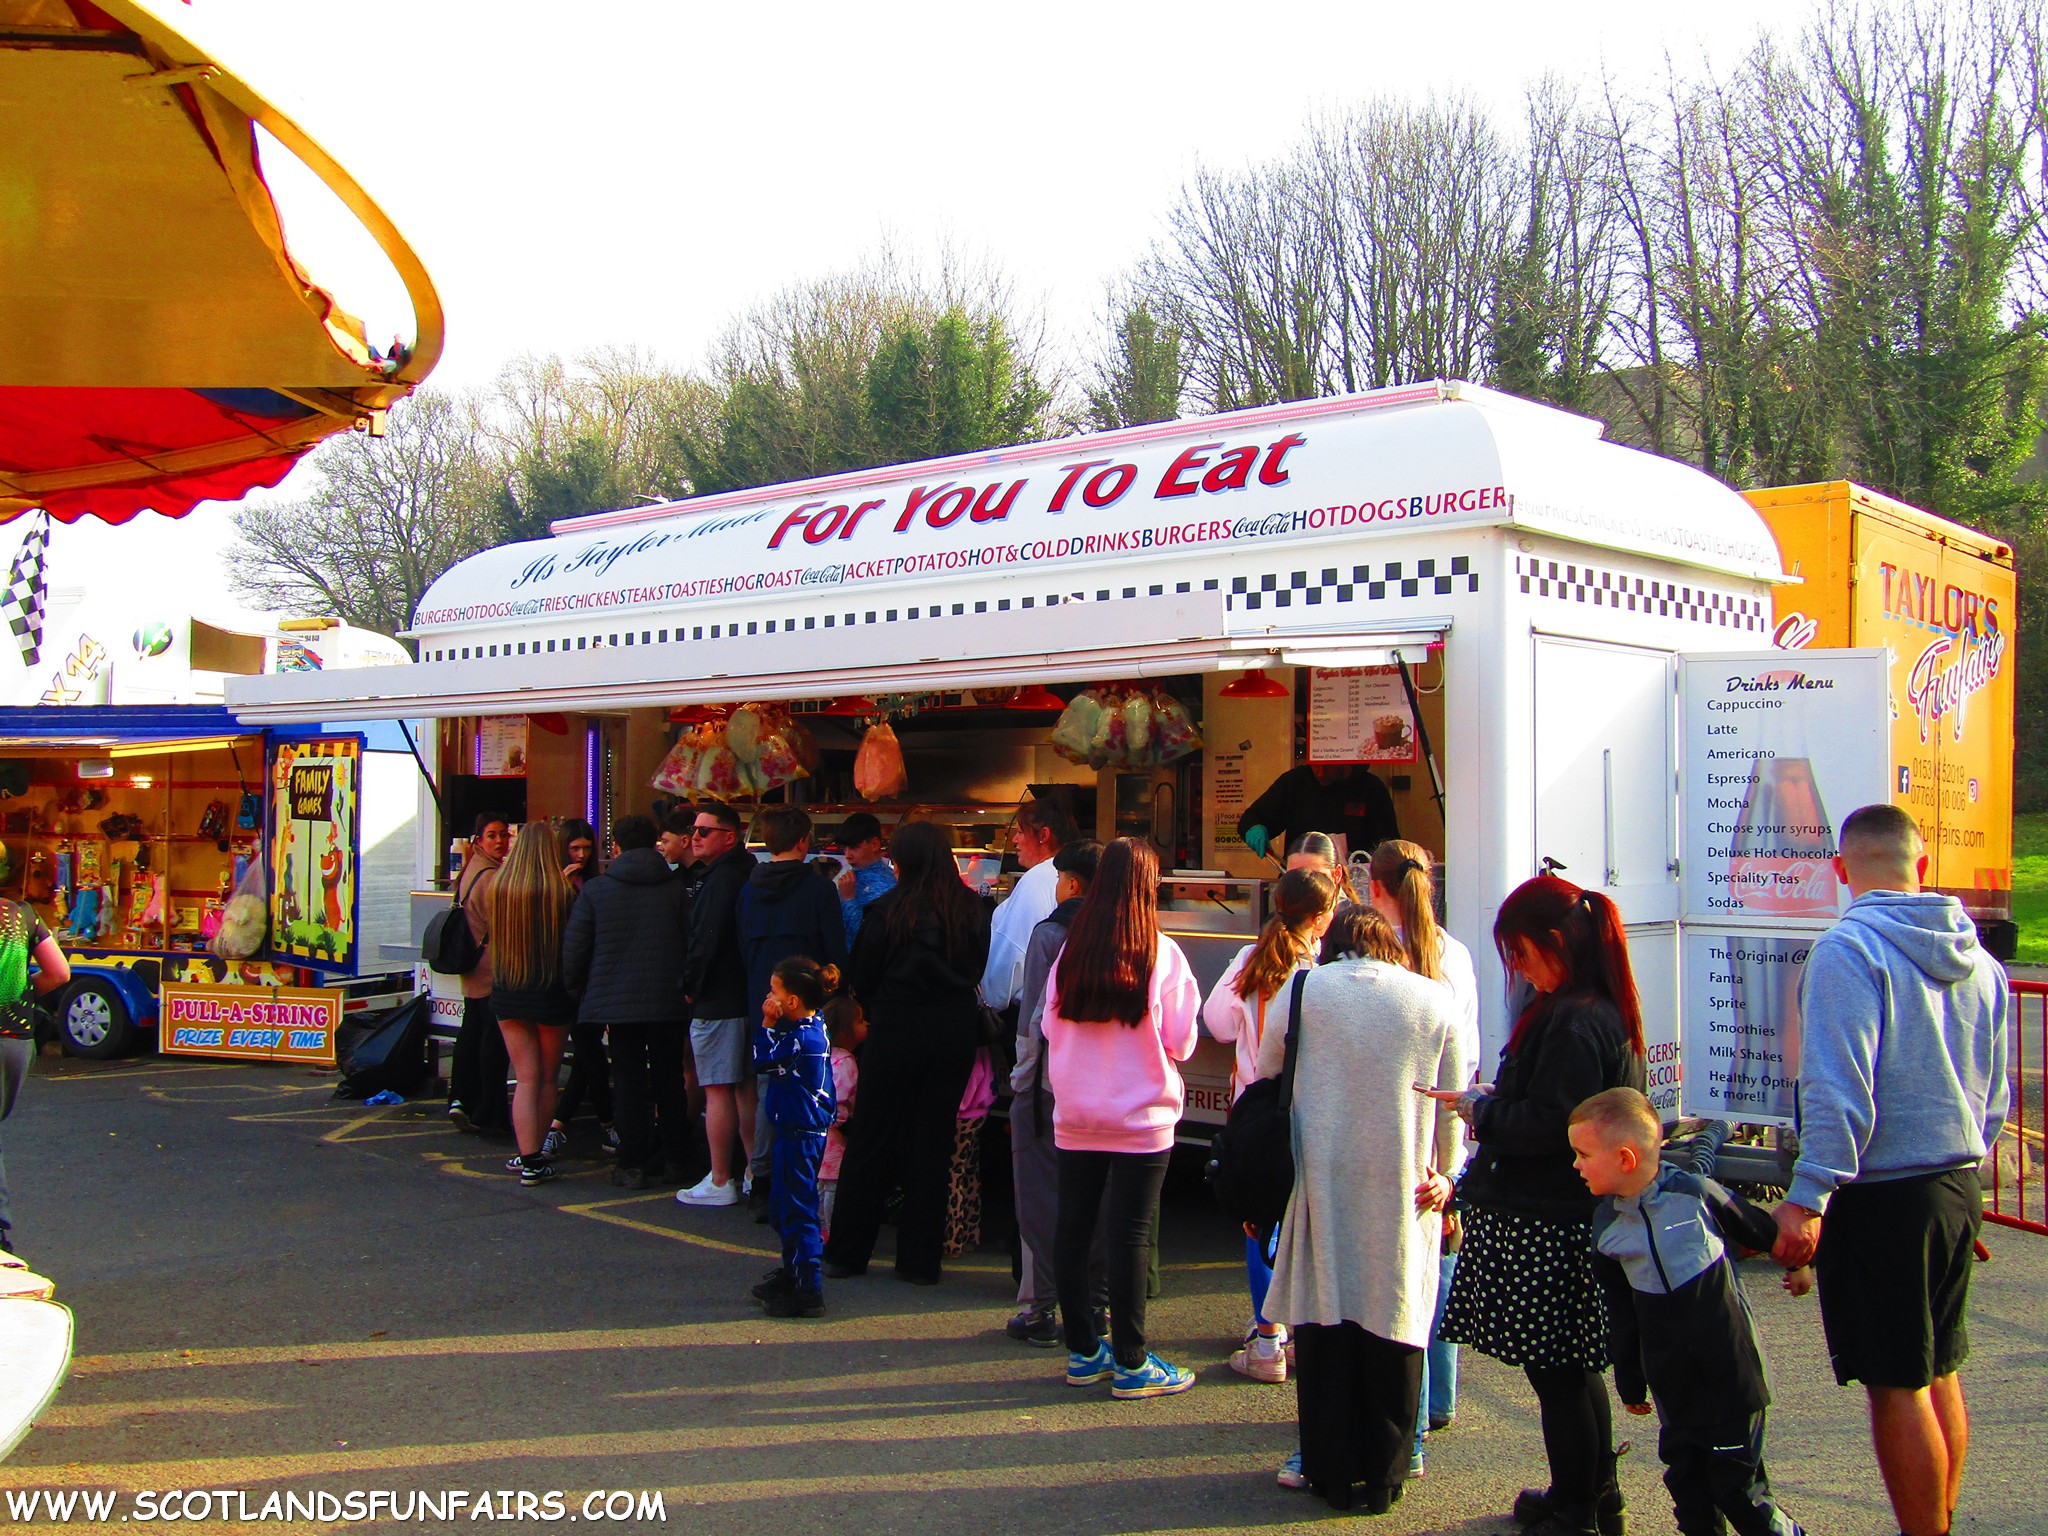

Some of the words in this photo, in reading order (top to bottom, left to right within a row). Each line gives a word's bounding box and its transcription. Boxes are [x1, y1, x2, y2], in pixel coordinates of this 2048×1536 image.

[510, 553, 565, 589] Its
[564, 529, 676, 577] Taylor
[674, 505, 779, 542] Made
[766, 499, 886, 551] For
[893, 478, 1028, 535] You
[1047, 459, 1138, 515] To
[1154, 433, 1307, 500] Eat
[1879, 560, 1998, 645] TAYLOR'S
[1726, 675, 1780, 693] Drinks
[1786, 673, 1834, 690] Menu
[1907, 627, 2004, 744] Funfairs
[1707, 698, 1782, 713] Cappuccino
[1707, 724, 1738, 735] Latte
[1707, 748, 1776, 760] Americano
[295, 768, 331, 796] FAMILY
[1707, 773, 1761, 787] Espresso
[297, 796, 322, 816] GAMES
[1707, 797, 1749, 809] Mocha
[1707, 822, 1754, 834] Choose
[1756, 825, 1786, 837] your
[1789, 825, 1832, 838] syrups
[1919, 818, 1985, 849] funfairs.com
[1707, 846, 1751, 859] Deluxe
[1754, 847, 1778, 859] Hot
[1781, 847, 1840, 860] Chocolat
[1707, 871, 1768, 887] Speciality
[1771, 873, 1800, 885] Teas
[1707, 896, 1744, 908] Sodas
[1709, 948, 1732, 960] The
[1736, 949, 1788, 965] Original
[1709, 971, 1744, 985] Fanta
[1709, 996, 1746, 1010] Sprite
[171, 998, 330, 1029] PULL-A-STRING
[1709, 1020, 1775, 1037] Smoothies
[174, 1027, 224, 1047] PRIZE
[228, 1029, 285, 1049] EVERY
[288, 1031, 326, 1050] TIME
[1709, 1045, 1736, 1059] Milk
[1739, 1048, 1783, 1063] Shakes
[1709, 1070, 1758, 1088] Healthy
[1709, 1086, 1720, 1098] &
[1723, 1089, 1766, 1103] more!!
